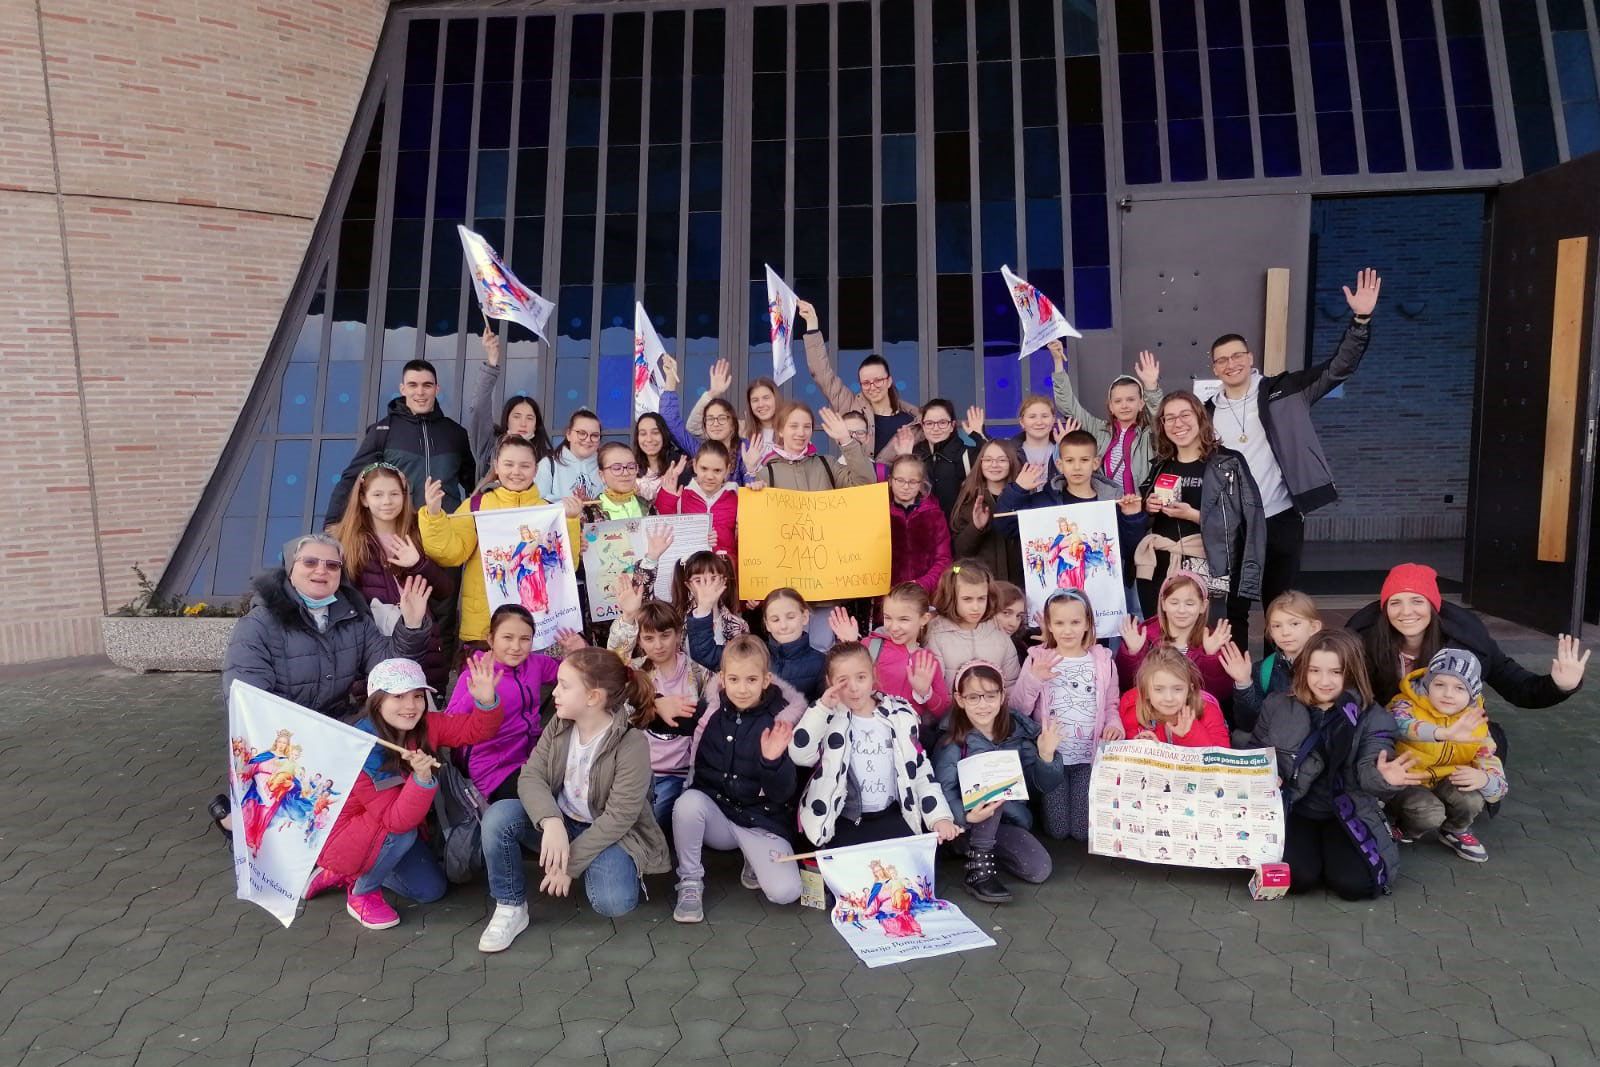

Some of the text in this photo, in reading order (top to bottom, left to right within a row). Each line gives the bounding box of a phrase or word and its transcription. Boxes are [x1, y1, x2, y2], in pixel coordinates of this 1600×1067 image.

[795, 512, 815, 526] ZA
[780, 523, 825, 542] GANU
[774, 544, 828, 571] 2140
[865, 760, 874, 772] &
